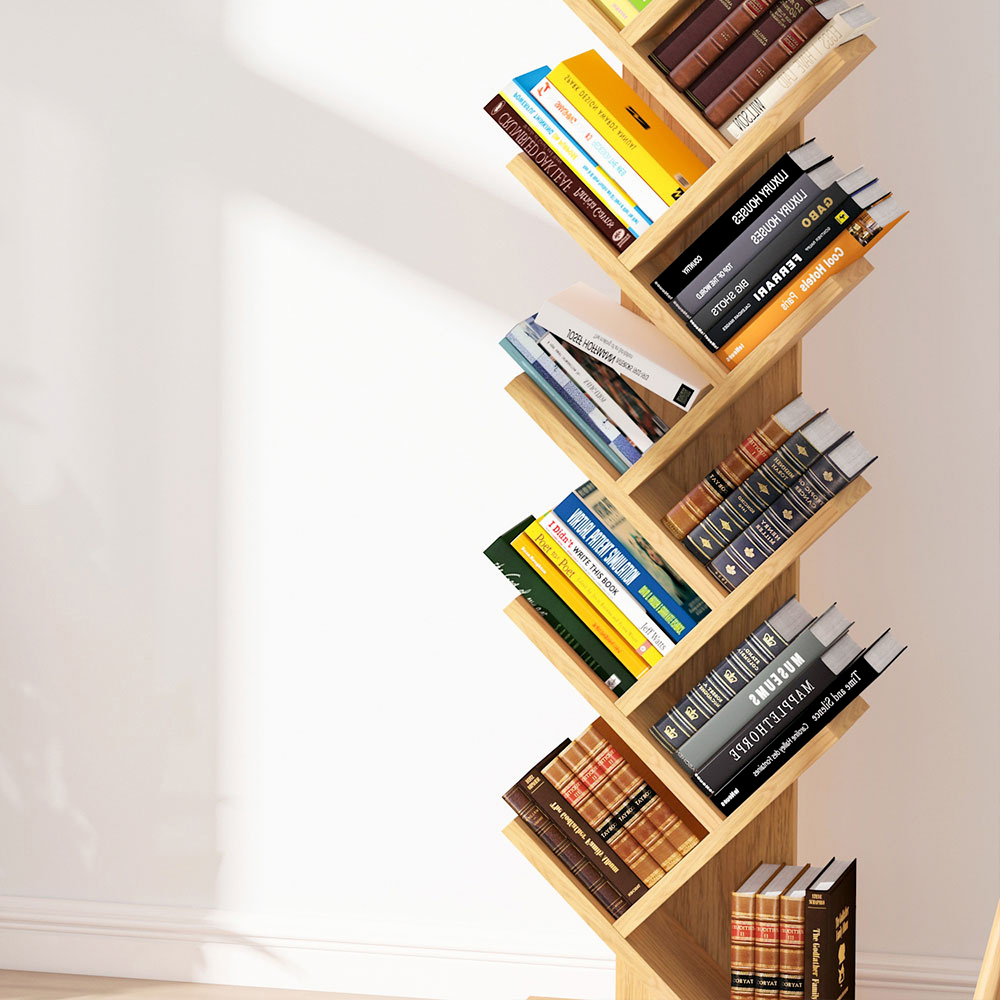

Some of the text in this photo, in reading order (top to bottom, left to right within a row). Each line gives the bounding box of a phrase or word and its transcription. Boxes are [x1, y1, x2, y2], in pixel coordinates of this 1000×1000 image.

[533, 533, 552, 553] Poet
[557, 558, 575, 577] Poet
[566, 507, 595, 539] VIRTUAL
[585, 528, 615, 557] PATIENT
[603, 547, 640, 585] SIMULATION
[572, 545, 591, 566] WRITE
[589, 563, 603, 579] THIS
[600, 576, 618, 595] BOOK
[639, 621, 654, 635] Jeff
[648, 630, 669, 651] Watts
[811, 928, 821, 1000] The Godfather Family
